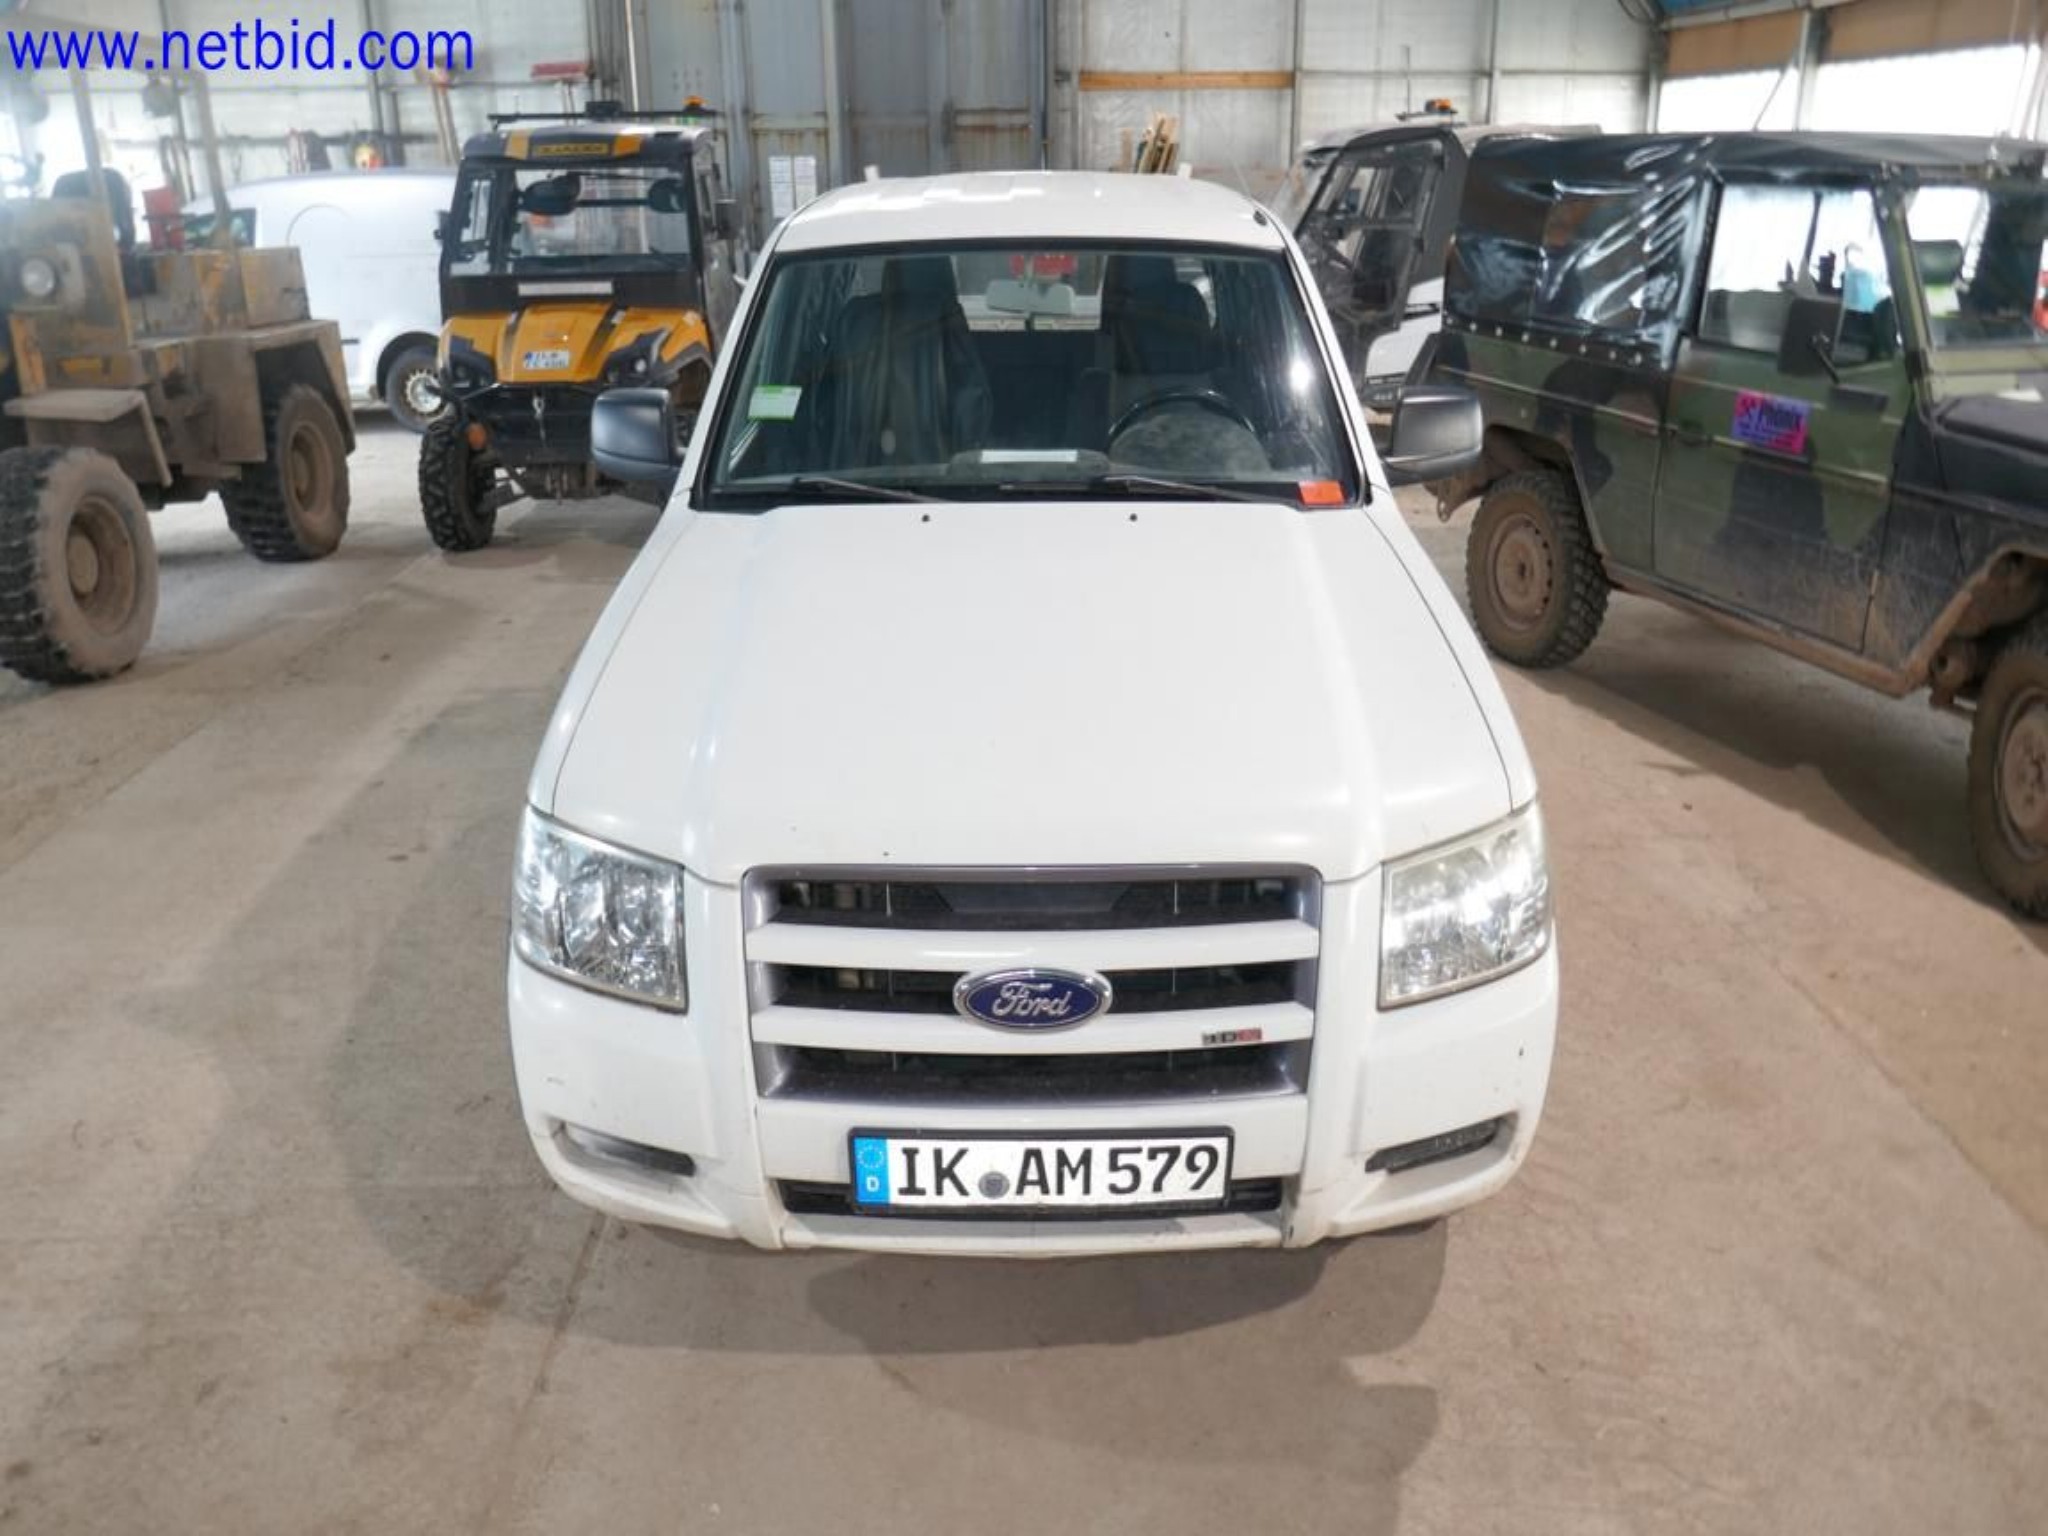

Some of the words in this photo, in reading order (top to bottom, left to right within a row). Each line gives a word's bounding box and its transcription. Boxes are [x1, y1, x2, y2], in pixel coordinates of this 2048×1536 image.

[992, 981, 1073, 1016] Ford
[865, 1176, 880, 1192] D
[898, 1147, 970, 1197] IK
[1014, 1146, 1092, 1196] AM
[1107, 1145, 1219, 1195] 579
